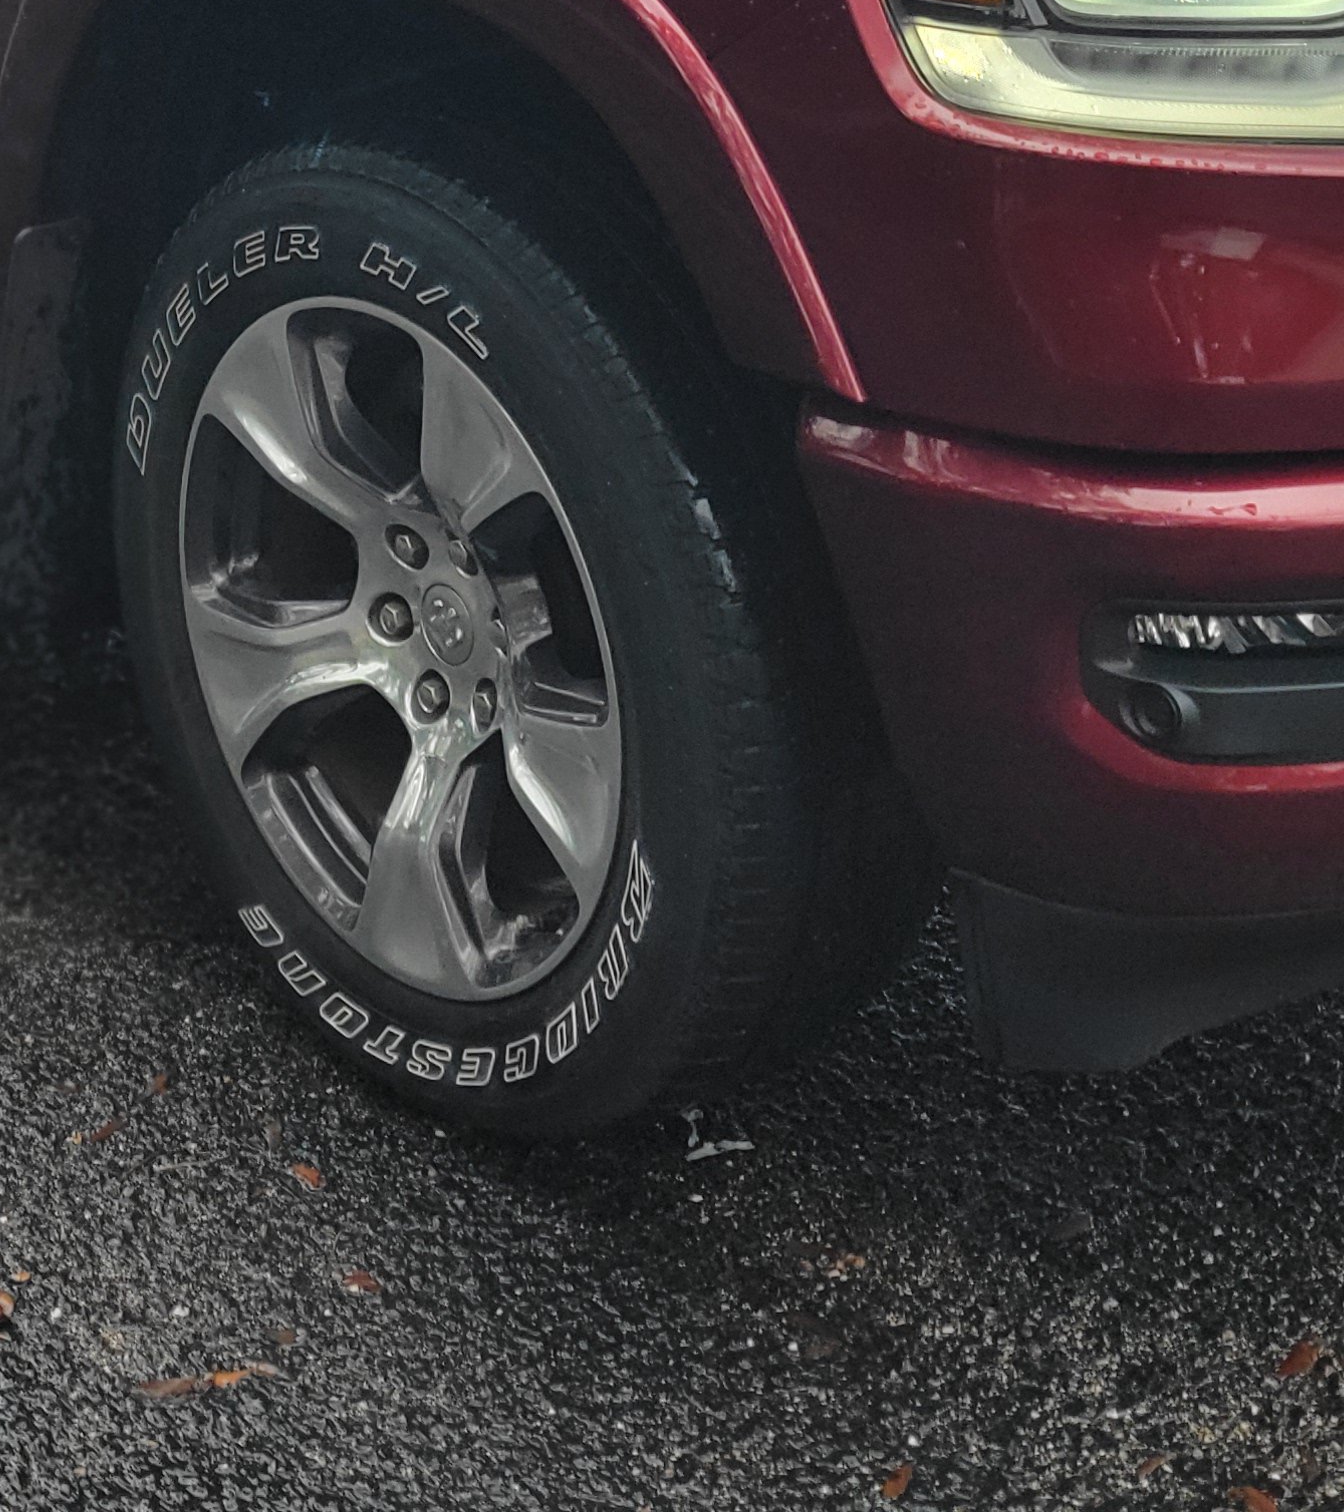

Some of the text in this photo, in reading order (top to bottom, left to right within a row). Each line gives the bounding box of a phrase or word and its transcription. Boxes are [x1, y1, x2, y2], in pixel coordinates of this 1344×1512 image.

[126, 224, 489, 476] DUELER H/L
[237, 838, 655, 1087] BRIDGESTONE
